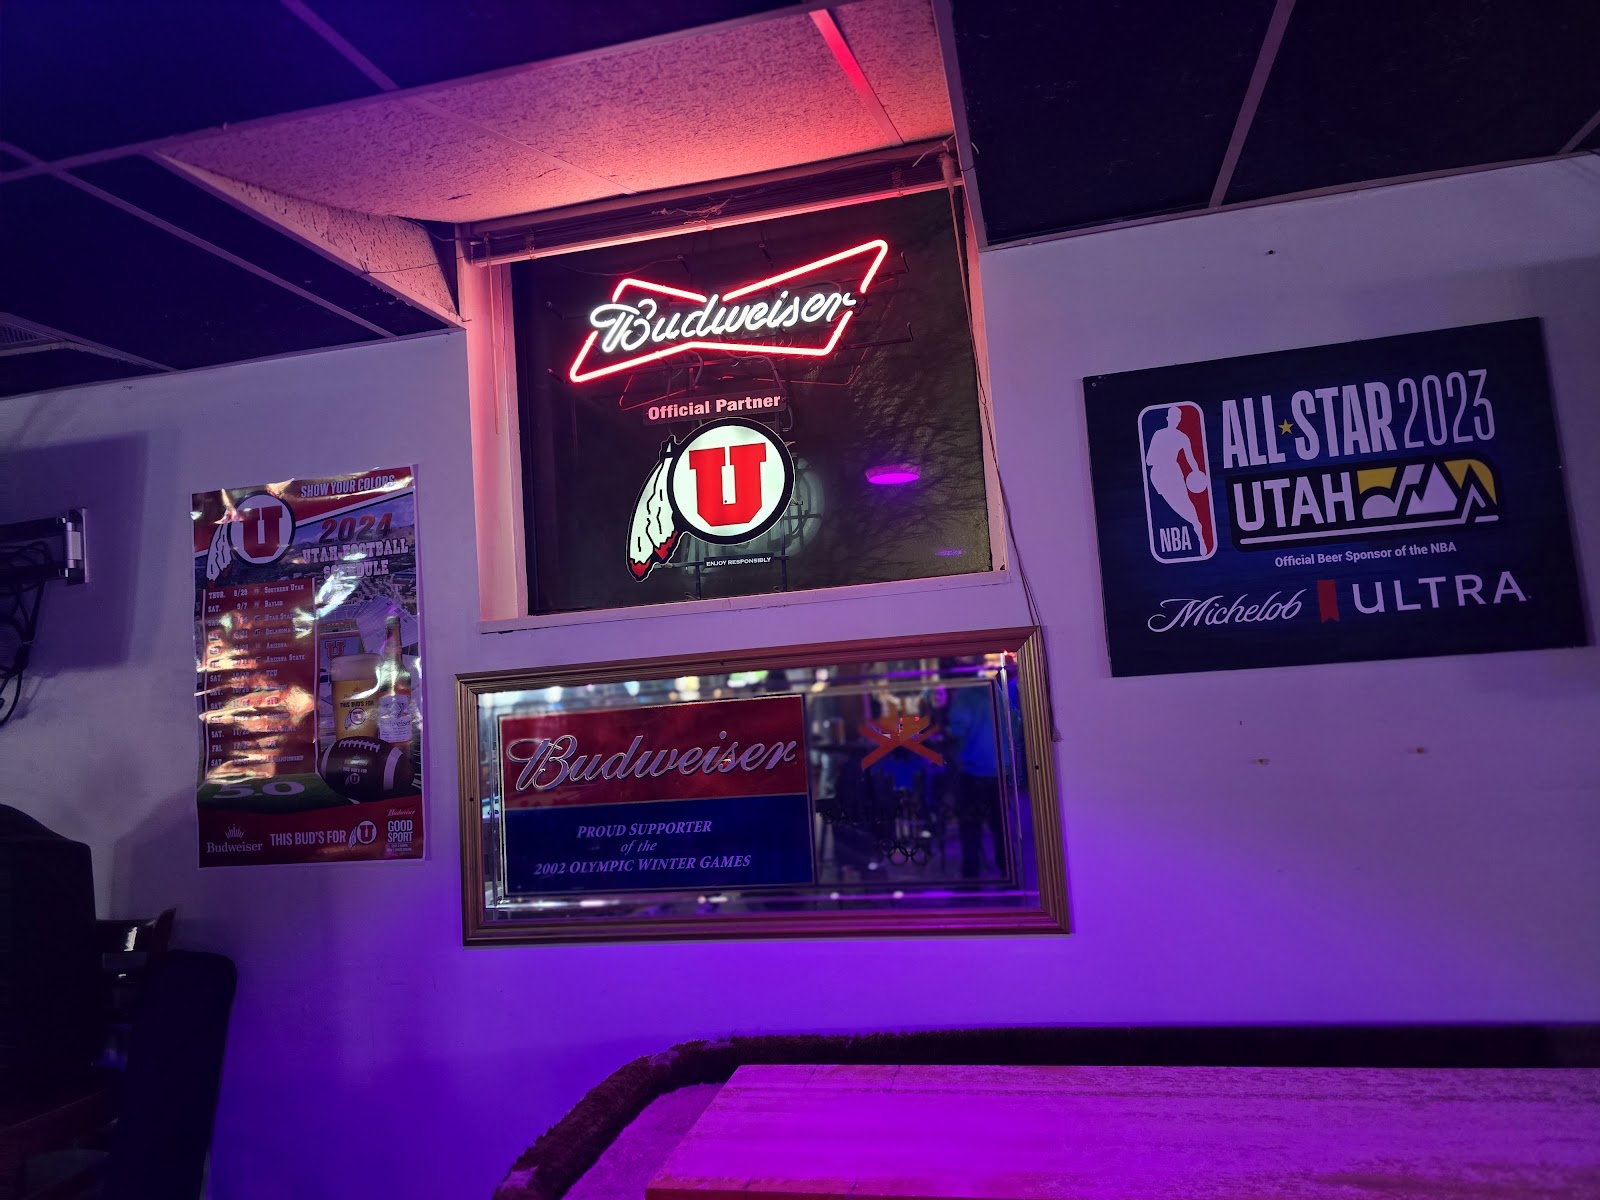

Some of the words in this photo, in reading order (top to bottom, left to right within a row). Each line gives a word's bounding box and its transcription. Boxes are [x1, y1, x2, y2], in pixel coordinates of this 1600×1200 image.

[590, 291, 857, 354] Budweiser
[648, 403, 710, 421] Official
[715, 395, 781, 413] Partner
[1222, 394, 1286, 469] ALL
[1290, 382, 1398, 461] STAR
[1398, 369, 1496, 449] 2023
[301, 483, 330, 498] SHOW
[331, 479, 356, 495] YOUR
[688, 442, 767, 527] U
[1233, 471, 1356, 532] UTAH
[241, 505, 283, 558] U
[319, 512, 393, 544] 2024
[1159, 526, 1193, 553] NBA
[302, 546, 338, 563] UTAH
[341, 538, 409, 559] FOOTBALL
[706, 559, 727, 567] ENJOY
[727, 556, 772, 566] RESPONSIBLY
[1274, 554, 1315, 568] Official
[1317, 551, 1343, 565] Beer
[1345, 547, 1392, 564] Sponsor
[1394, 546, 1407, 558] of
[1409, 545, 1428, 557] the
[1431, 541, 1457, 554] NBA
[1147, 588, 1307, 633] Michelob
[1352, 570, 1527, 614] ULTRA
[506, 730, 797, 792] Budweiser
[270, 832, 294, 846] THIS
[295, 831, 325, 845] BUD'S
[326, 830, 347, 843] FOR
[387, 819, 413, 833] GOOD
[387, 831, 414, 843] SPORT
[577, 824, 627, 839] PROUD
[628, 820, 713, 837] SUPPORTER
[206, 841, 263, 854] Budweiser
[620, 841, 634, 855] of
[637, 839, 658, 852] the
[533, 862, 567, 876] 2002
[569, 859, 635, 874] OLYMPIC
[638, 857, 696, 872] WINTER
[700, 854, 752, 869] GAMES
